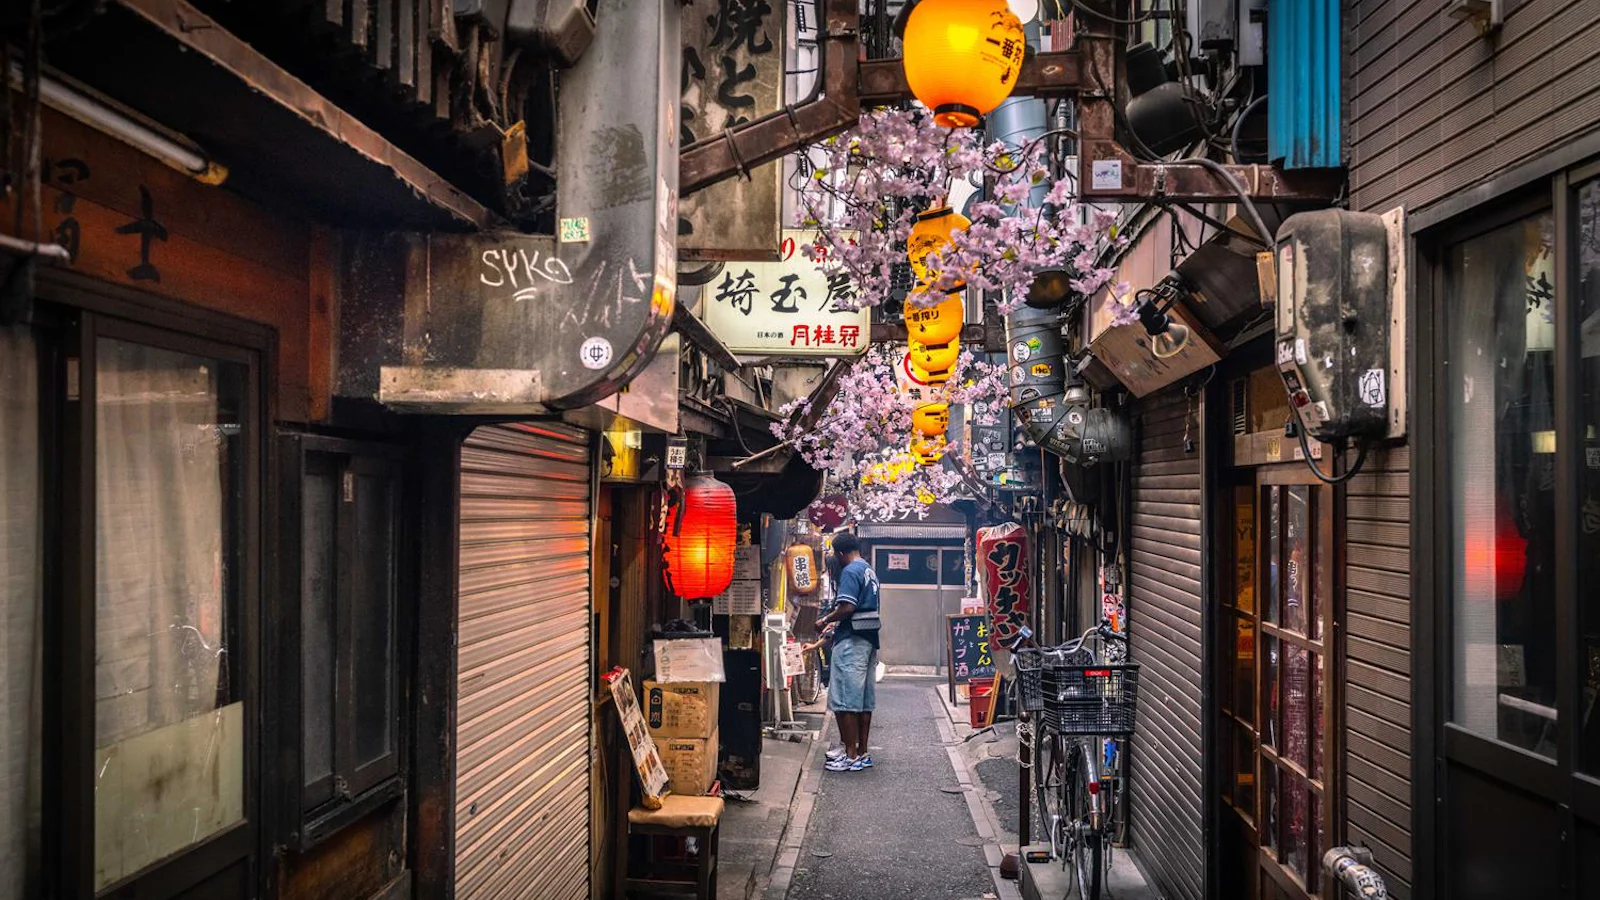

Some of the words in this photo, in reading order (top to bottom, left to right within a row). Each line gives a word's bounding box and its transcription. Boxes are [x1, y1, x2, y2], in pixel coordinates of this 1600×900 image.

[715, 269, 860, 316] 埼玉屋
[790, 324, 860, 348] 月桂冠
